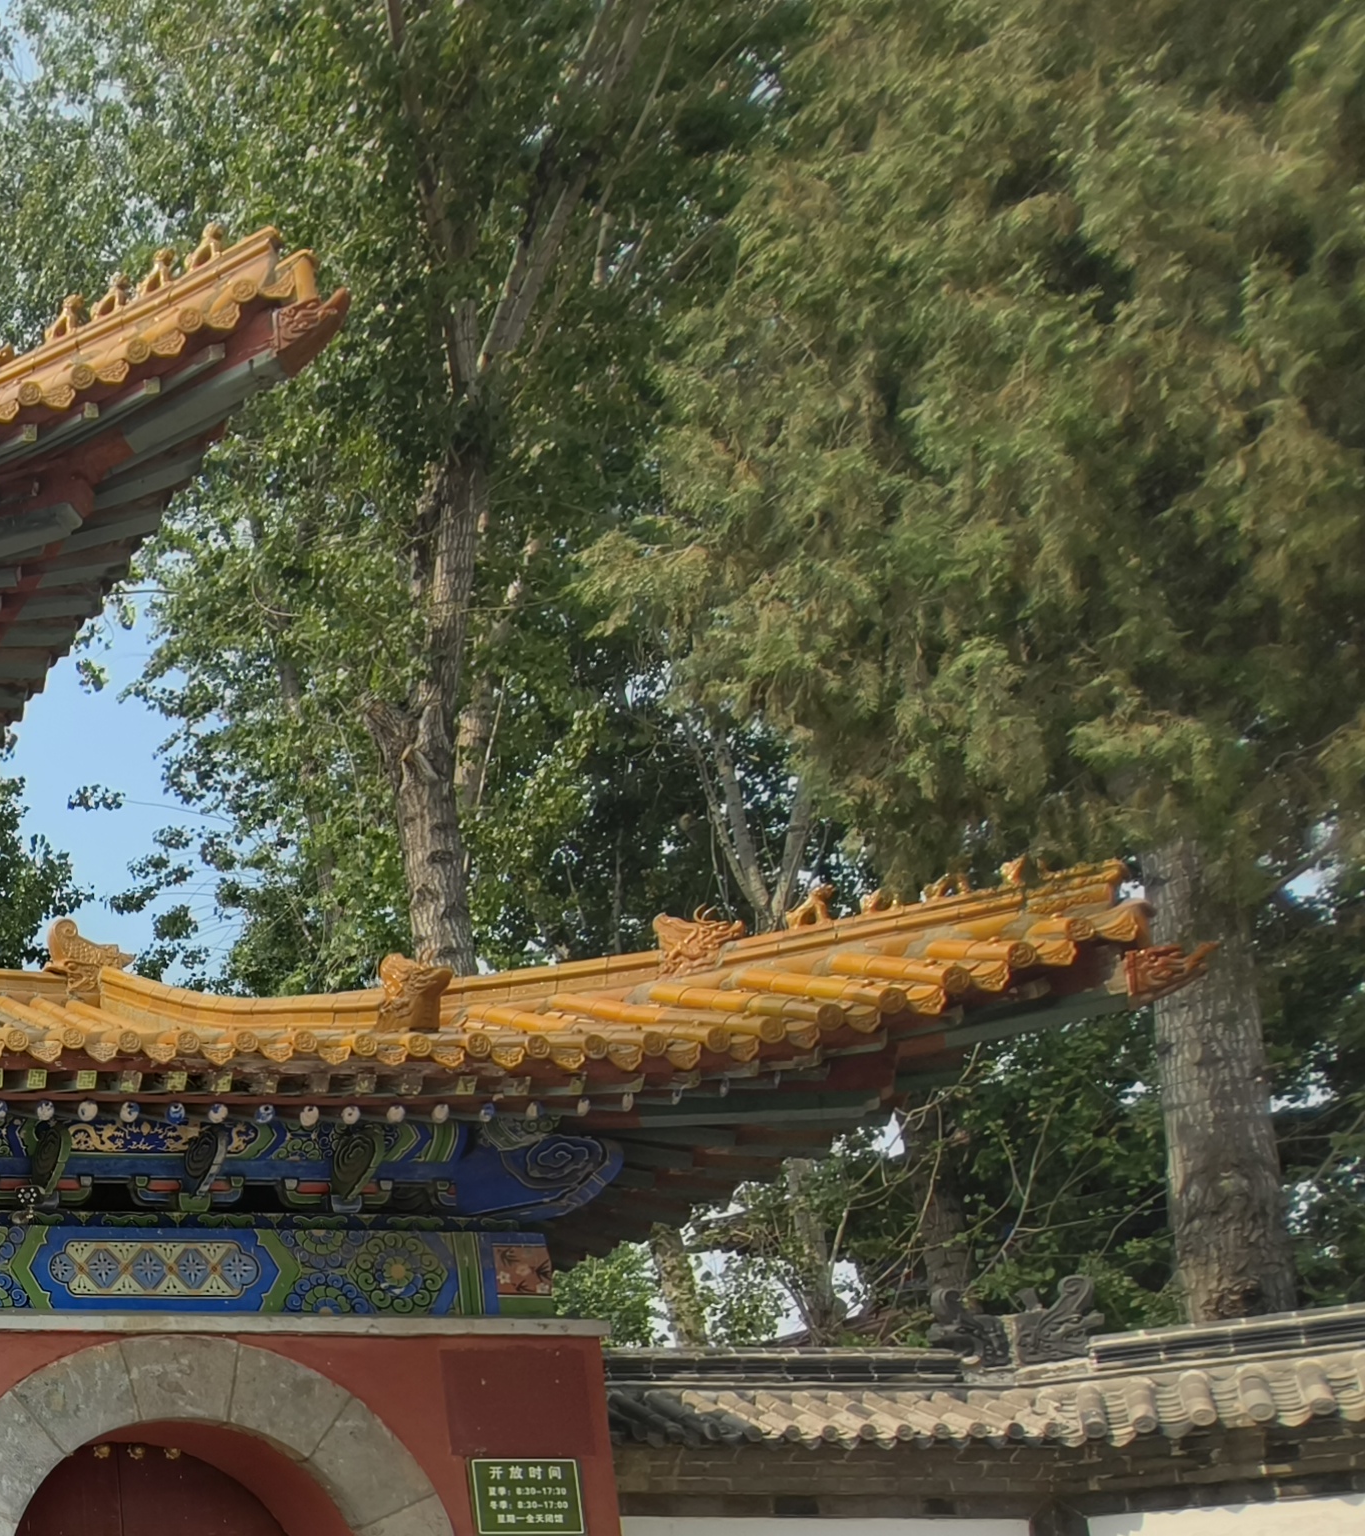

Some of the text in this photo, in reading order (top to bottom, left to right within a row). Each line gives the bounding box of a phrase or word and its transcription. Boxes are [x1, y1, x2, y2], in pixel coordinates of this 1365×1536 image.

[489, 1466, 562, 1480] 开放时间
[497, 1514, 564, 1524] 星期一全天闭馆
